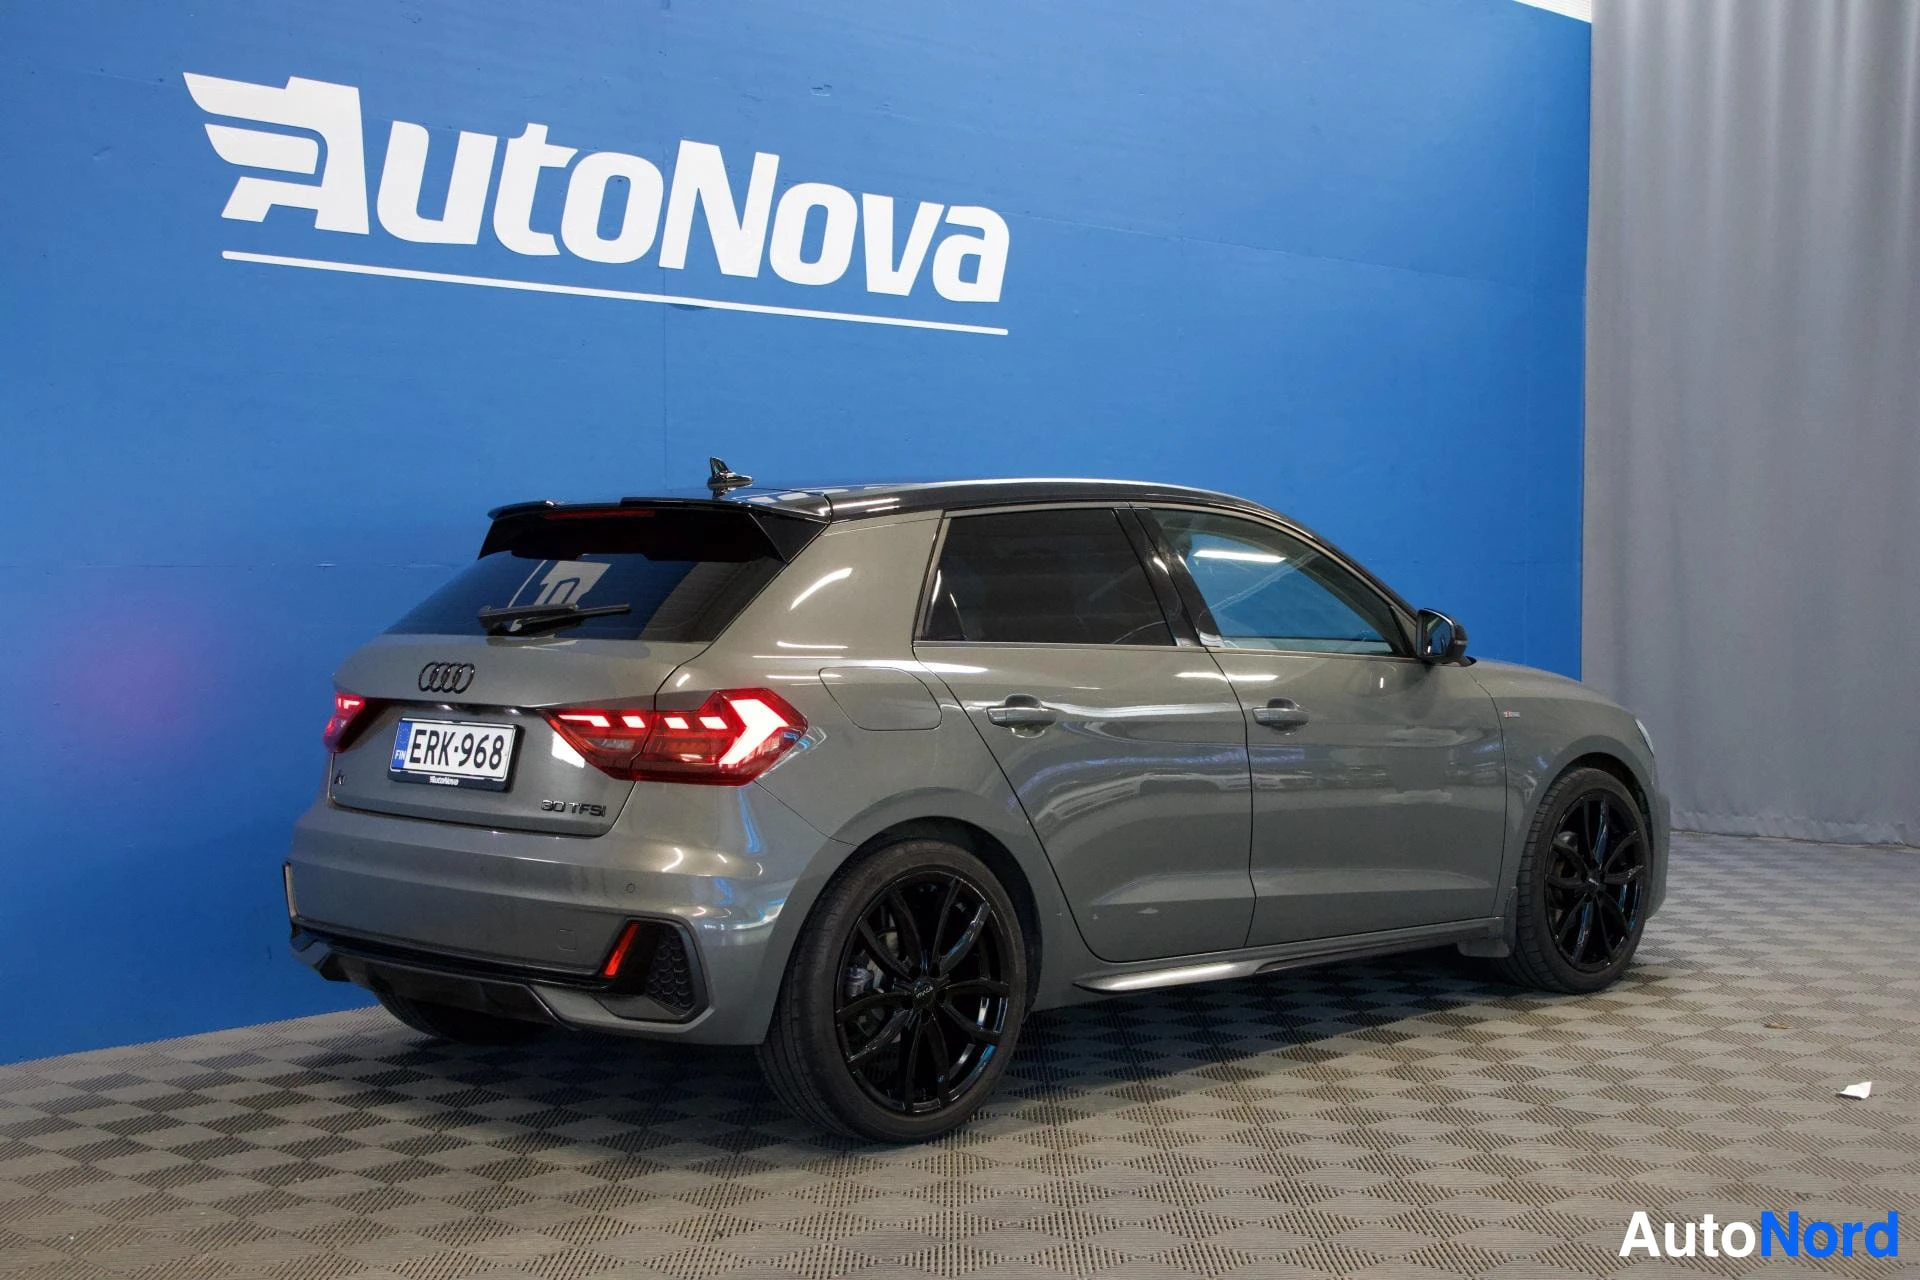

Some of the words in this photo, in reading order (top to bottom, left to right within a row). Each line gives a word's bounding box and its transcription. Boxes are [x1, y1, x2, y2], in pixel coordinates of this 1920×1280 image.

[183, 72, 1010, 303] AutoNova
[409, 728, 504, 770] ERK-968
[541, 799, 566, 812] 30
[568, 802, 607, 817] TFSI
